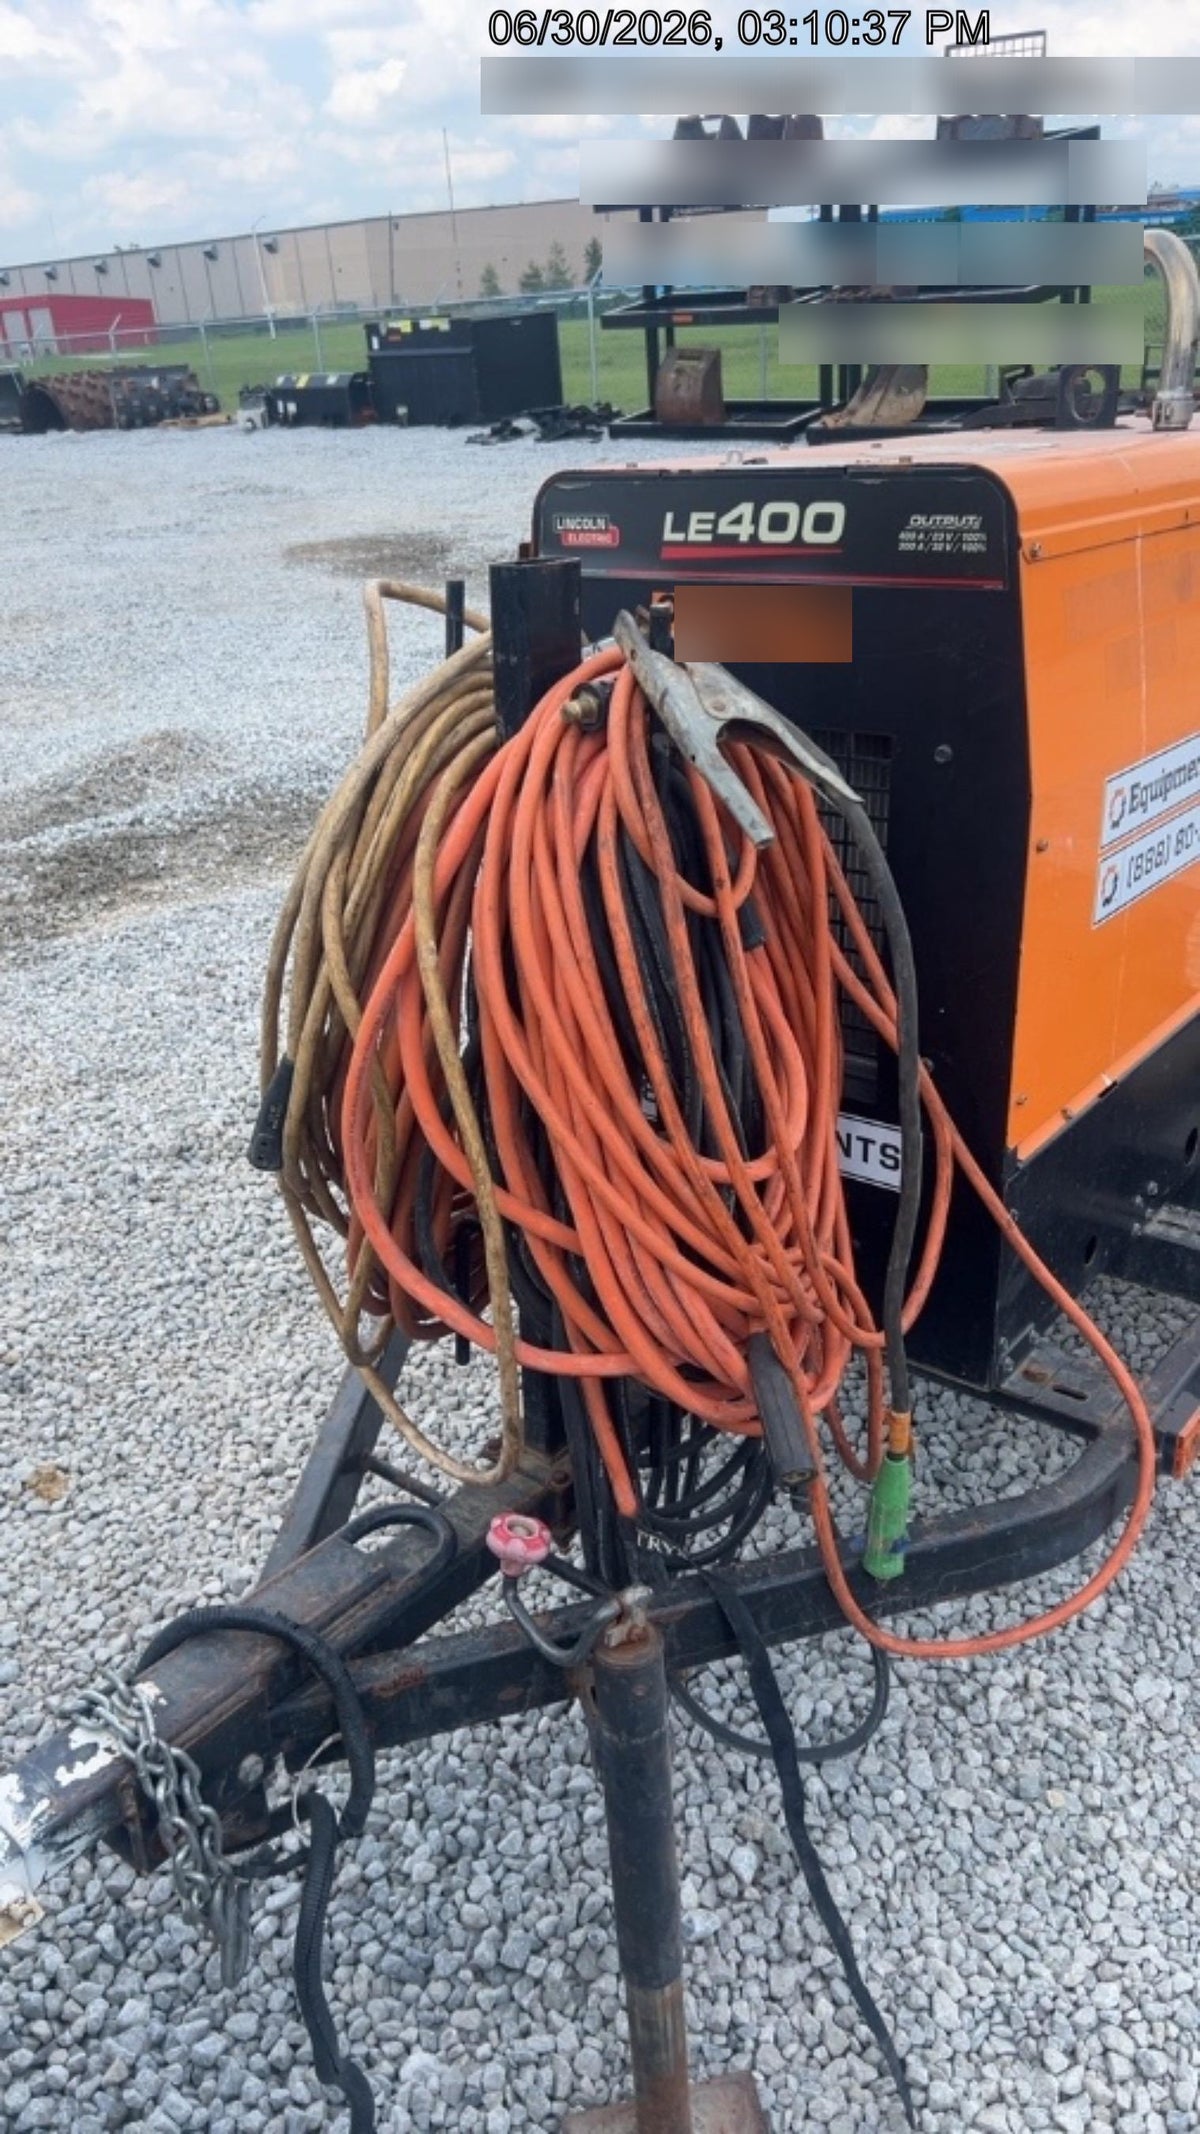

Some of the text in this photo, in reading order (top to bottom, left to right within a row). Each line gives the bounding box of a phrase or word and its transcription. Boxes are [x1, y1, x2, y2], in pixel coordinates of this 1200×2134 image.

[556, 516, 606, 530] LINCOLN
[663, 502, 846, 543] LE400
[567, 532, 612, 544] ELECTRIC
[836, 1132, 900, 1171] NTS
